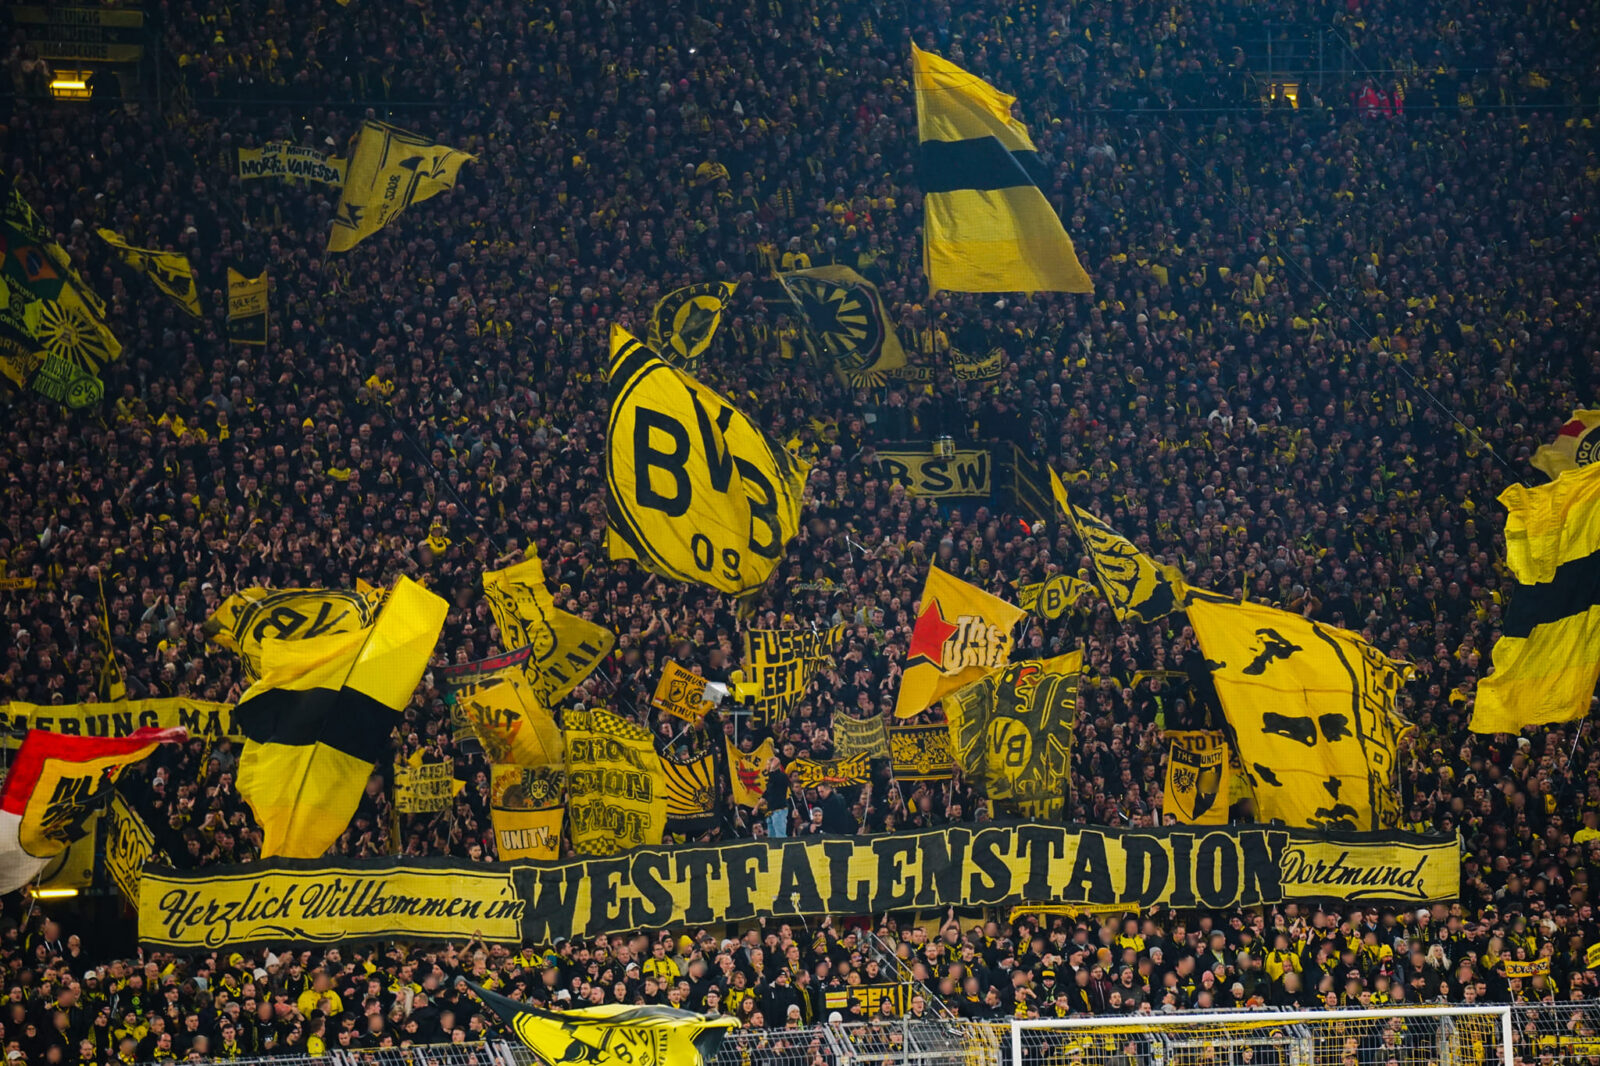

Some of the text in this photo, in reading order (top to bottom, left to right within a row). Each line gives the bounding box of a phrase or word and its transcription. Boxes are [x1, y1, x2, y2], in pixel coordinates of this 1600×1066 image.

[288, 159, 340, 182] VANESSA
[633, 384, 782, 559] BVB
[691, 533, 741, 581] 09
[751, 625, 842, 664] FUSSBALL
[1177, 750, 1193, 763] THE
[501, 826, 550, 851] UNITY
[159, 882, 299, 948] Herzlich
[299, 877, 480, 920] Willkommen
[483, 887, 526, 921] im
[512, 825, 1290, 943] WESTFALENSTADION
[1281, 848, 1428, 892] Dortmund
